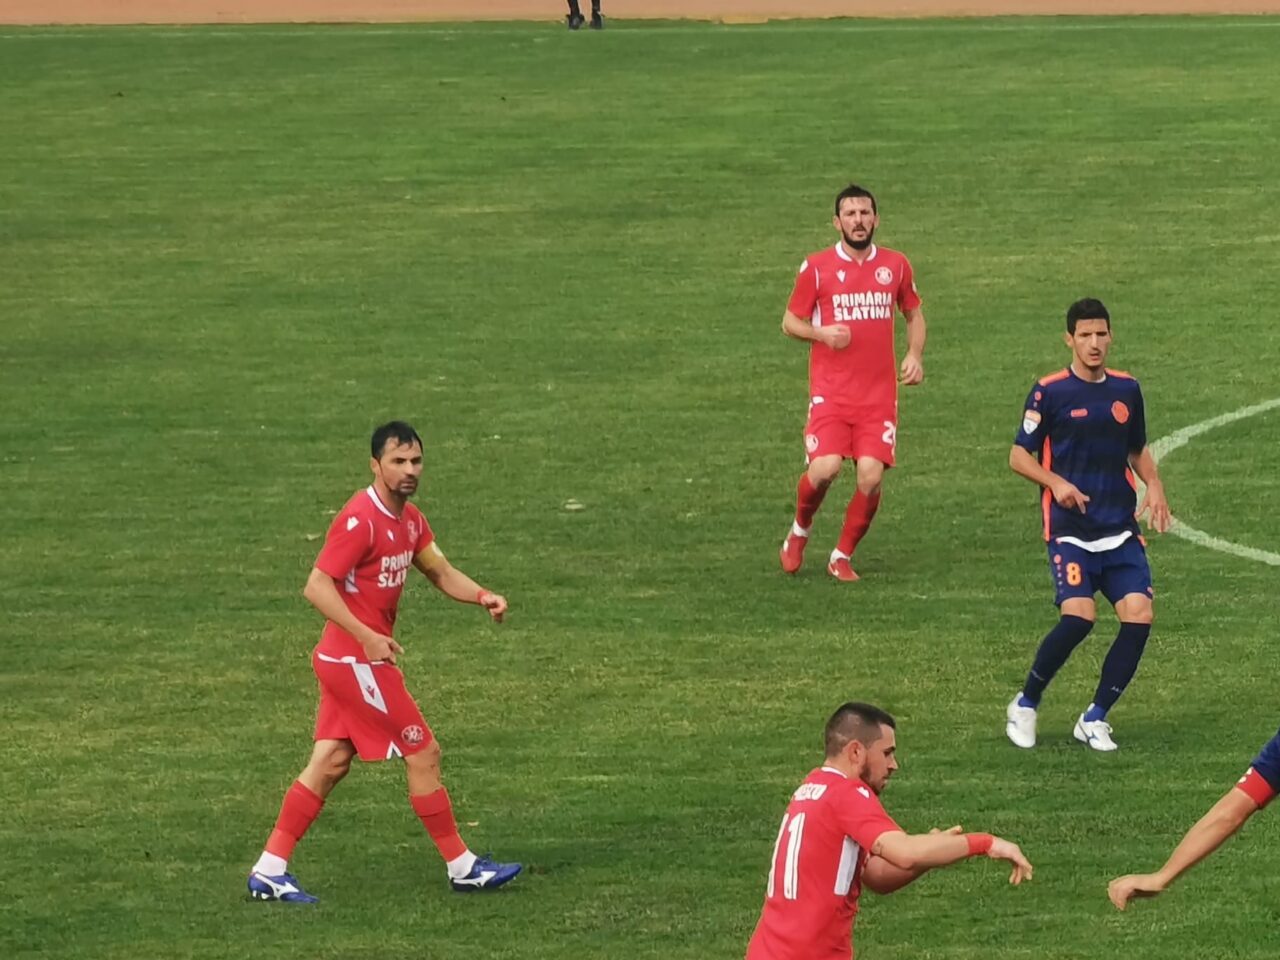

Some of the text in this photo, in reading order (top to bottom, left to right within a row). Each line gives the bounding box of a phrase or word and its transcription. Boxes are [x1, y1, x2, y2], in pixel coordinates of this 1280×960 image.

[833, 305, 891, 321] SLATINA
[882, 420, 896, 445] 2
[1066, 562, 1081, 586] 8
